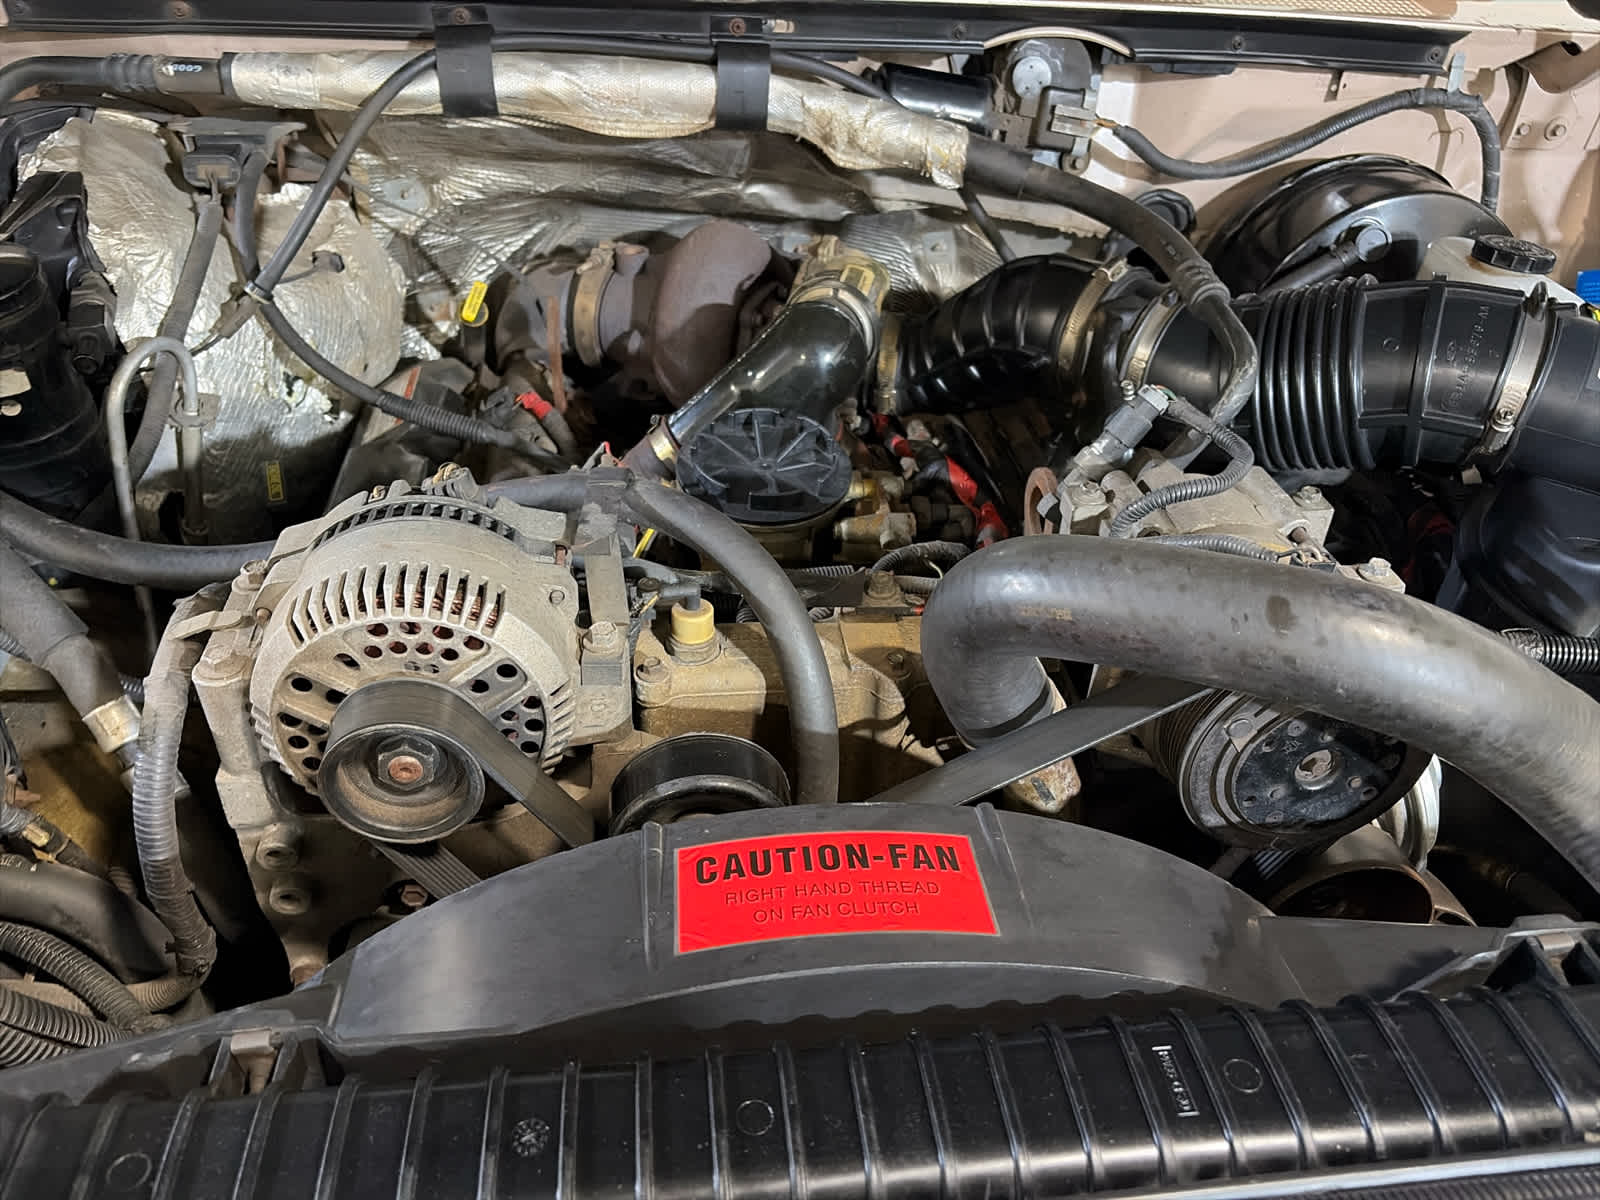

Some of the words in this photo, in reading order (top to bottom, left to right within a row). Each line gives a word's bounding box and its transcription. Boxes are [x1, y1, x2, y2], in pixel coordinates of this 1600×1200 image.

[695, 843, 961, 884] CAUTION-FAN
[725, 886, 785, 905] RIGHT
[794, 882, 851, 897] HAND
[858, 881, 940, 895] THREAD
[753, 909, 784, 923] ON
[791, 904, 831, 919] FAN
[837, 900, 920, 917] CLUTCH
